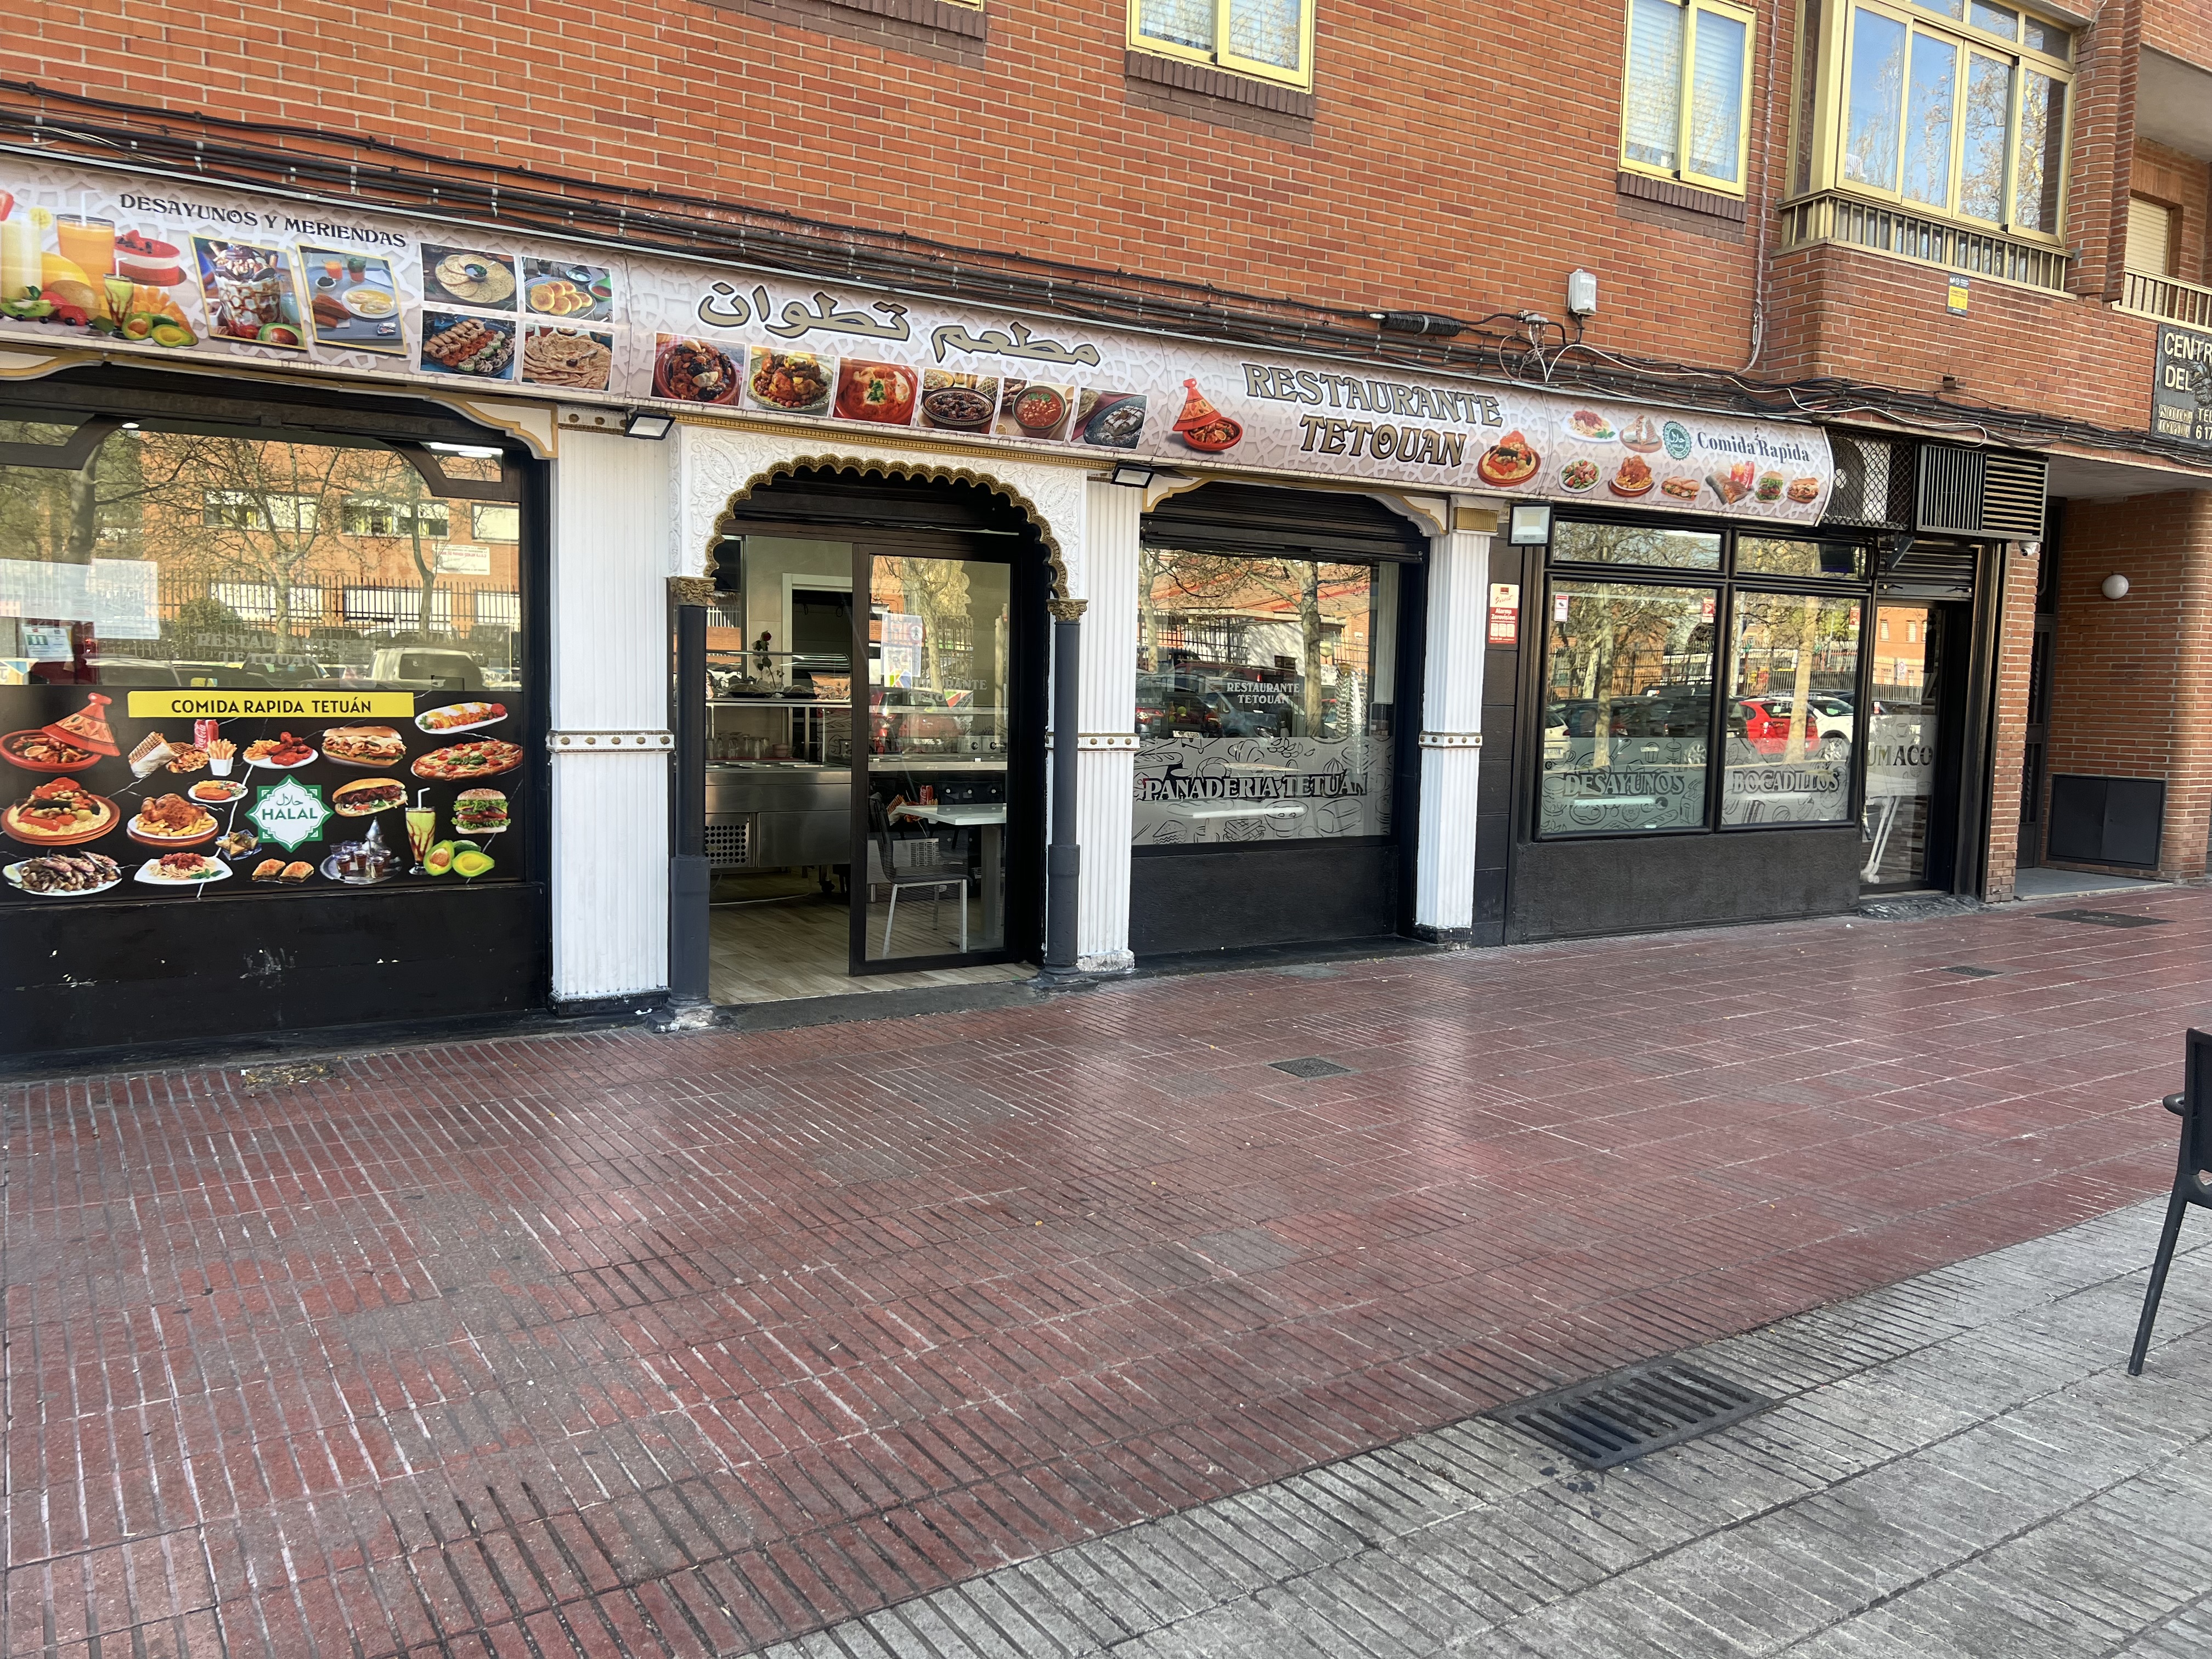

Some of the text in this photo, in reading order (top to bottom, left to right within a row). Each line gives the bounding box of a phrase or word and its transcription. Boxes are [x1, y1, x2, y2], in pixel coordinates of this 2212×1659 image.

[120, 194, 406, 247] DESAYUNOS Y MERIENDAS
[698, 281, 1101, 368] مطعم تطوان
[2164, 365, 2192, 392] DEL
[1242, 363, 1503, 428] RESTAURANTE
[2159, 404, 2193, 425] PSICOLOGIA
[2158, 419, 2191, 438] LOGOPEDIA
[1300, 414, 1466, 467] TETOUAN
[1697, 432, 1756, 455] Comida
[1756, 439, 1810, 464] Rapida
[196, 633, 338, 652] RESTAUANTE
[1227, 682, 1300, 693] RESTAURANTE
[171, 696, 372, 714] COMIDA RAPIDA TETUÁN
[1238, 695, 1289, 704] TETOUAN
[1145, 776, 1278, 800] PANADERIA
[1564, 772, 1685, 795] DESAYUNOS
[1733, 769, 1839, 793] BOCADILLOS
[276, 793, 303, 806] حلال
[262, 808, 318, 820] HALAL
